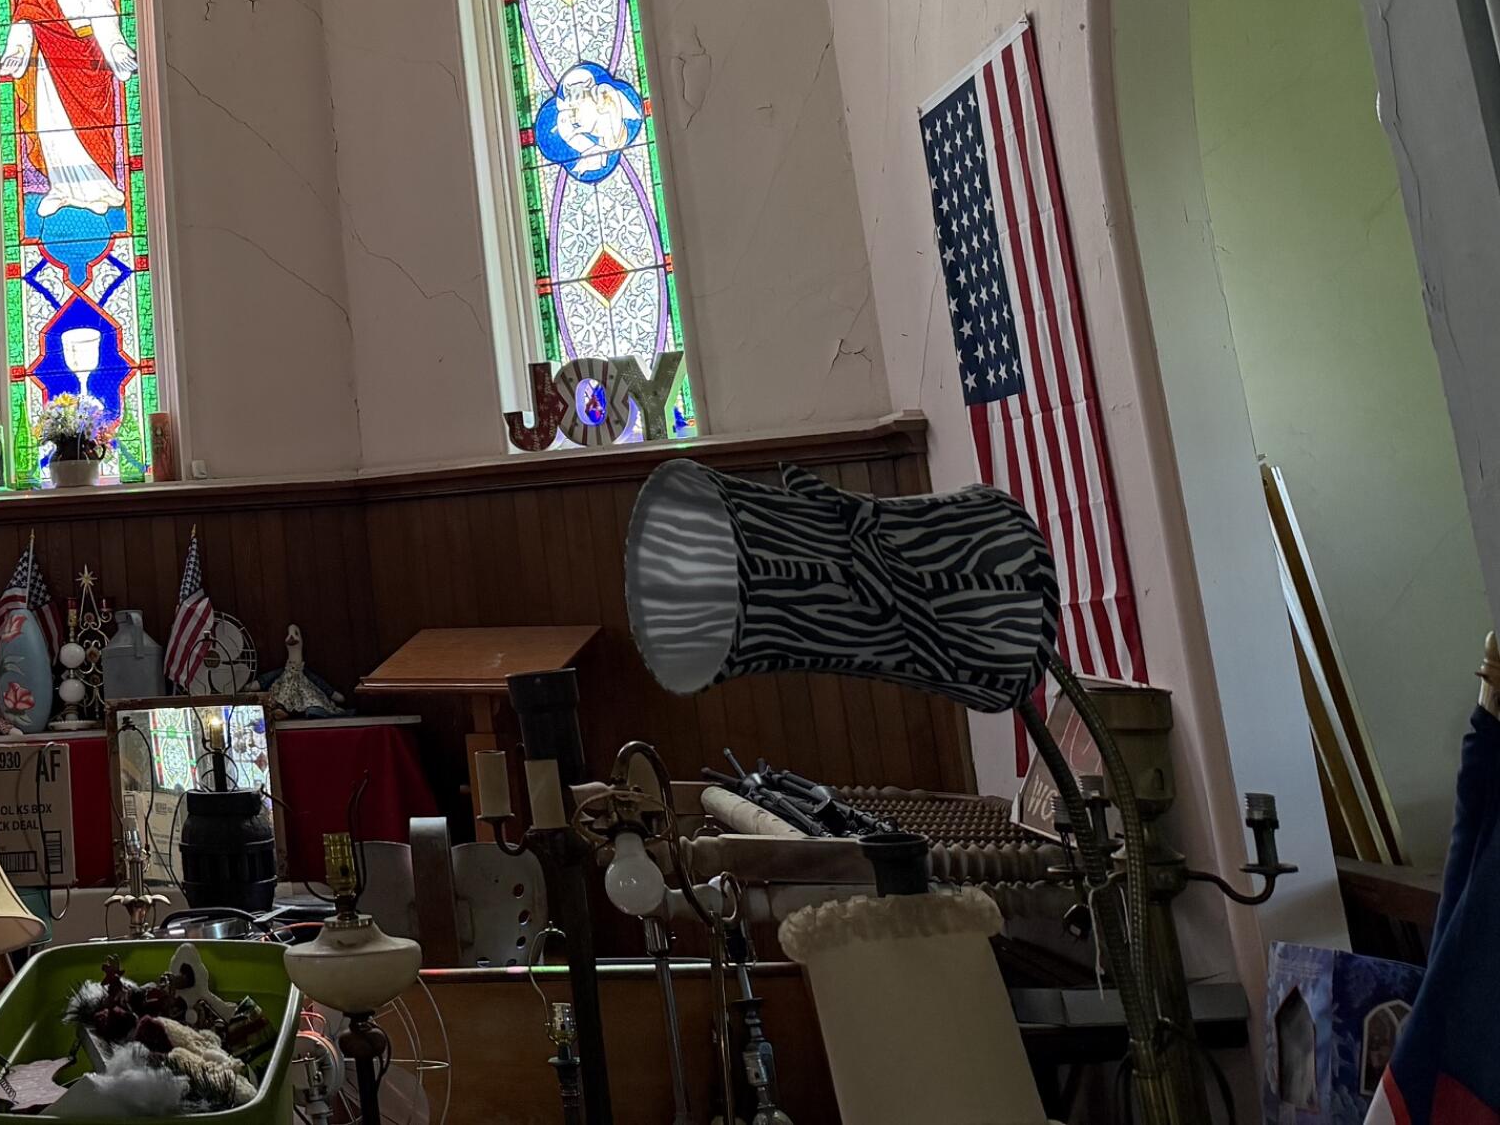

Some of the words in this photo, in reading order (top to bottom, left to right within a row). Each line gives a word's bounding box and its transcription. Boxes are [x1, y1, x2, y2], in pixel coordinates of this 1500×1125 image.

[503, 350, 685, 452] JOY
[35, 749, 61, 783] AF
[16, 805, 29, 815] KS
[31, 803, 52, 815] BOX
[12, 820, 39, 831] DEAL
